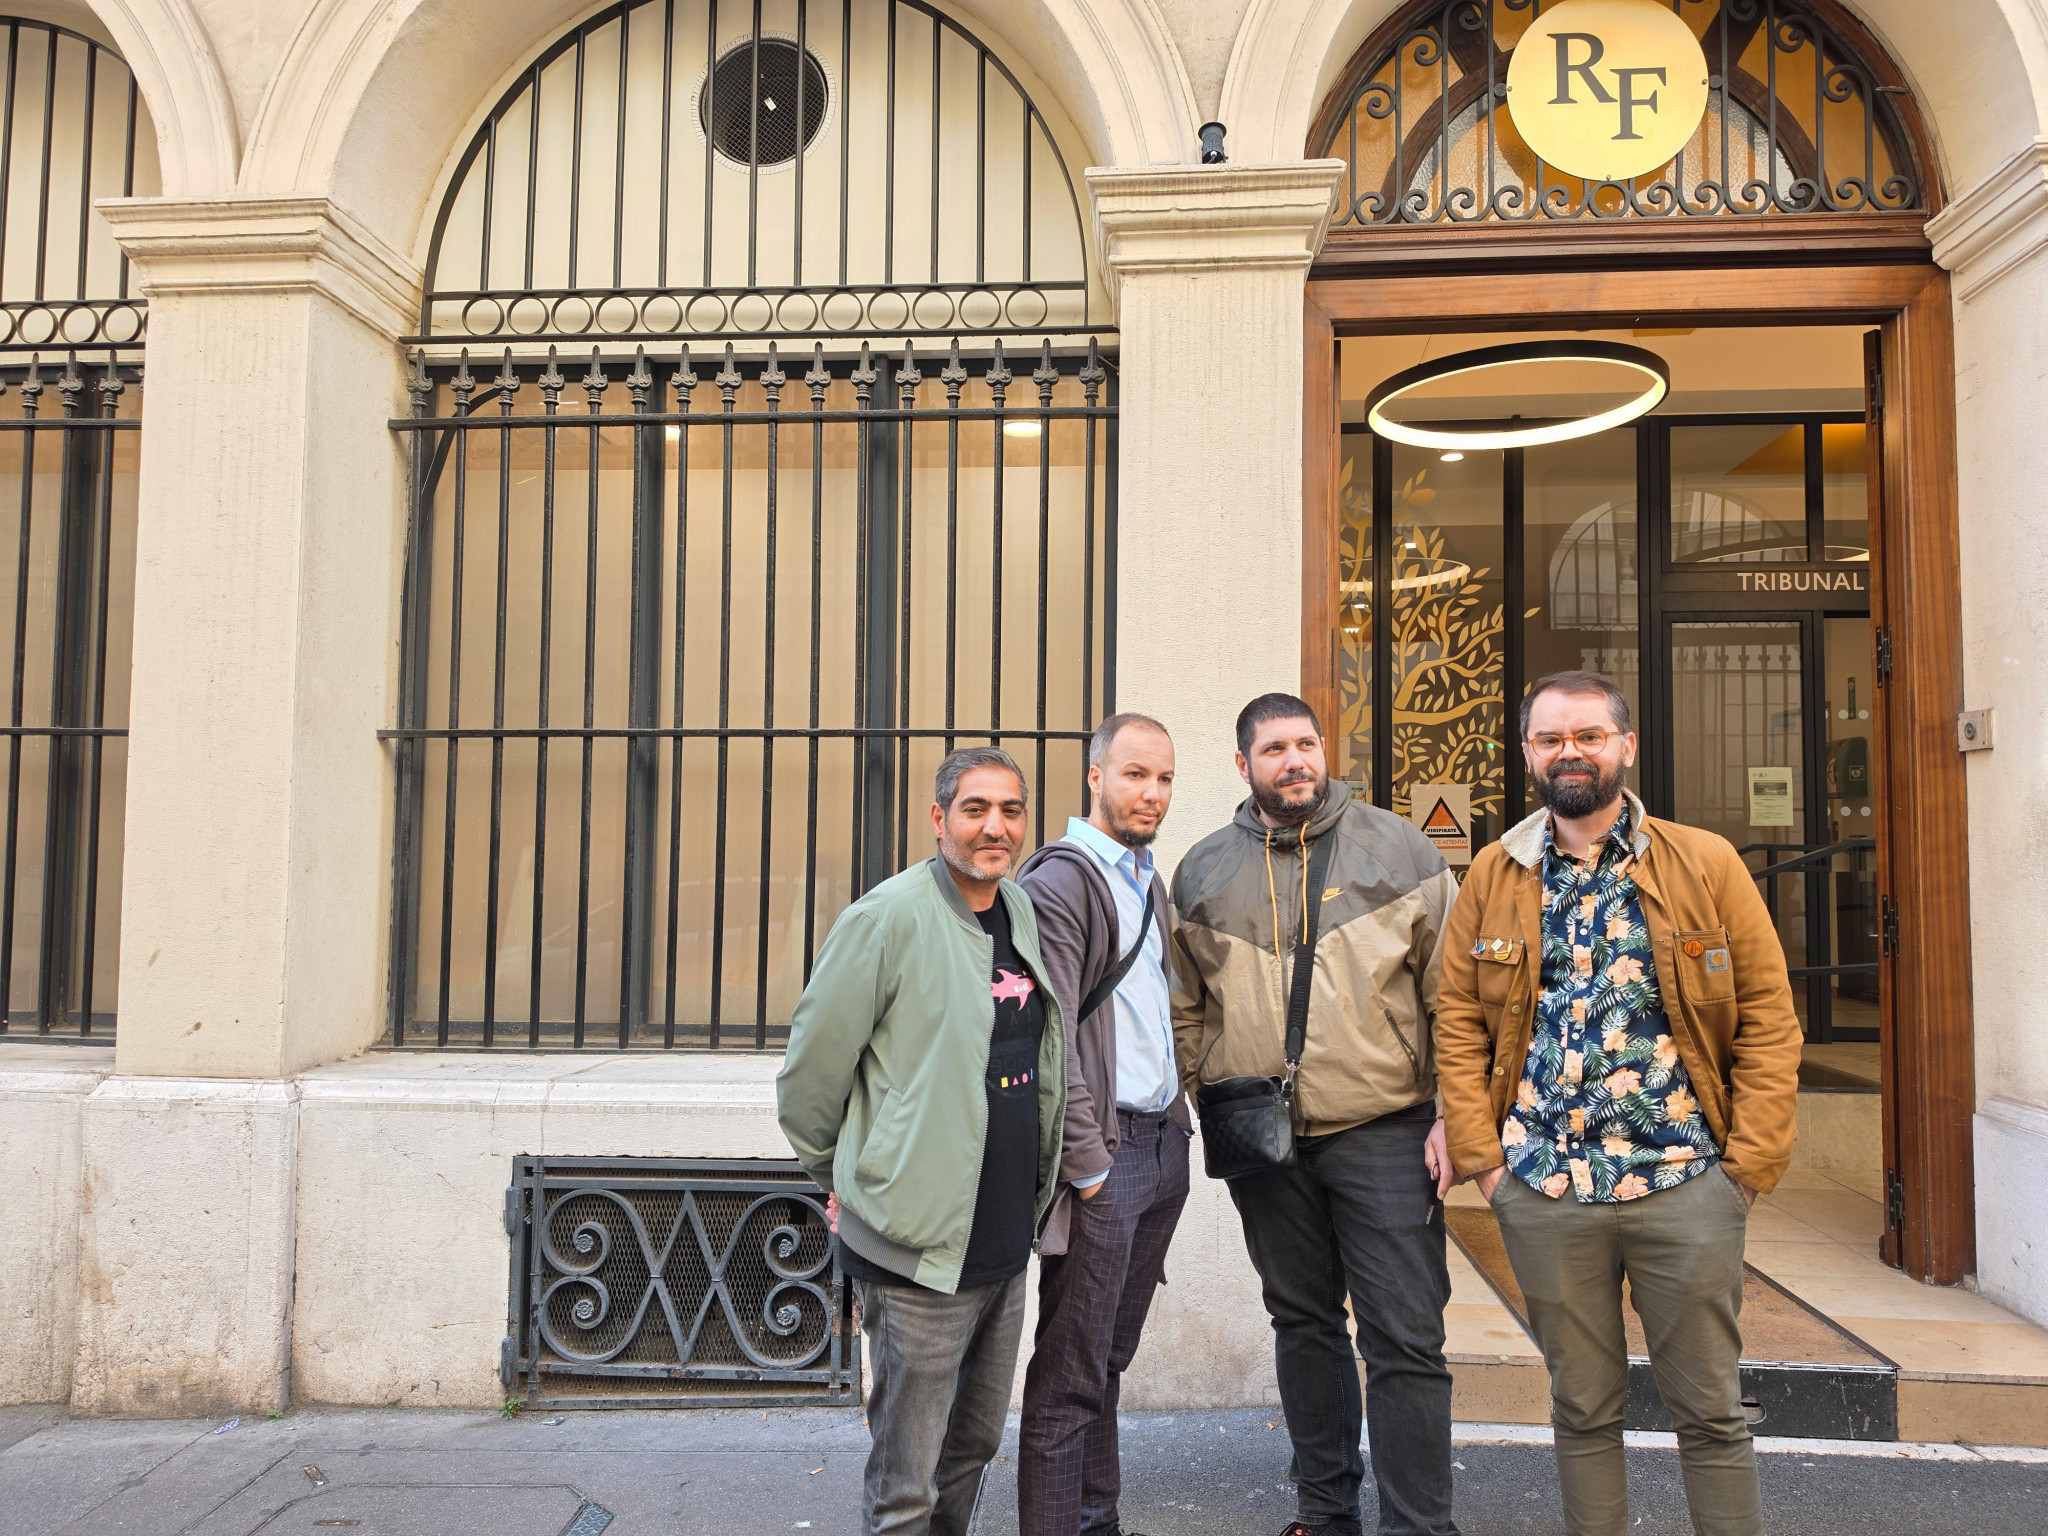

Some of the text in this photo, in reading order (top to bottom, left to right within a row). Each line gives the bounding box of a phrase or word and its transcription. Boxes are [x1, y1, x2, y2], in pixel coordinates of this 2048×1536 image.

[1547, 32, 1667, 140] RF
[1737, 572, 1865, 591] TRIBUNAL
[1324, 887, 1341, 896] NIKE
[1292, 985, 1307, 1027] VUITTON
